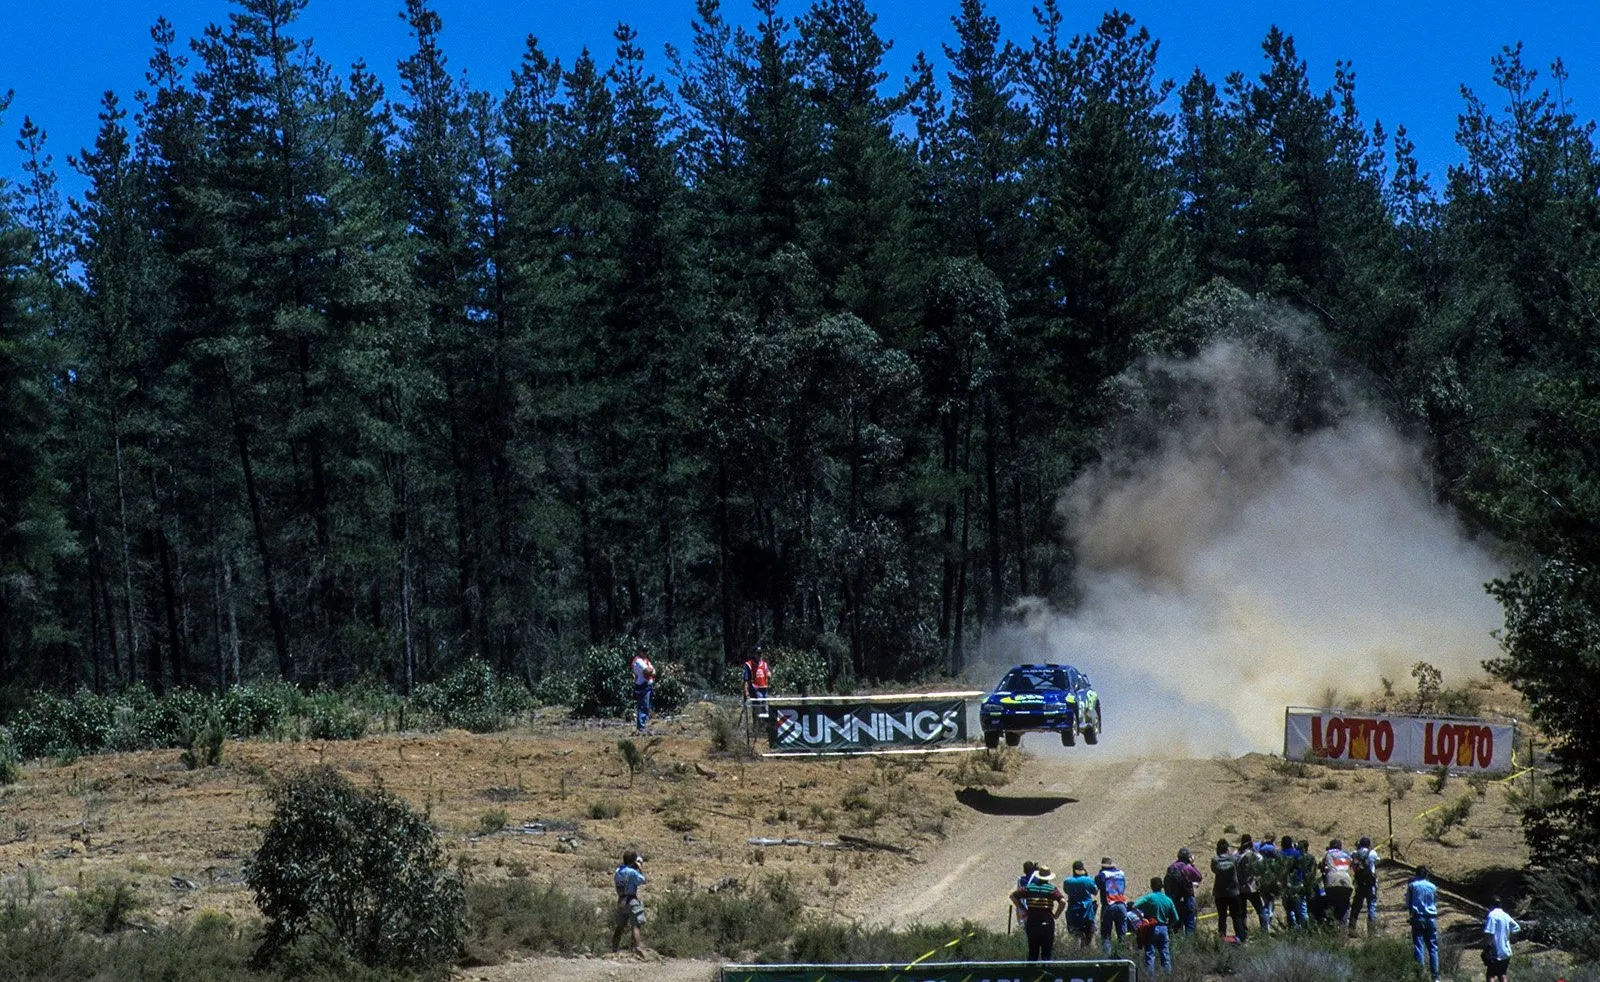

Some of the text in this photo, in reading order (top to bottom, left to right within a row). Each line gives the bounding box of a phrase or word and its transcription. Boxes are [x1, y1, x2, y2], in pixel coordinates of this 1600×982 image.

[777, 709, 959, 744] BUNNINGS
[1311, 716, 1394, 763] LOTTO
[1424, 723, 1493, 769] LOTTO
